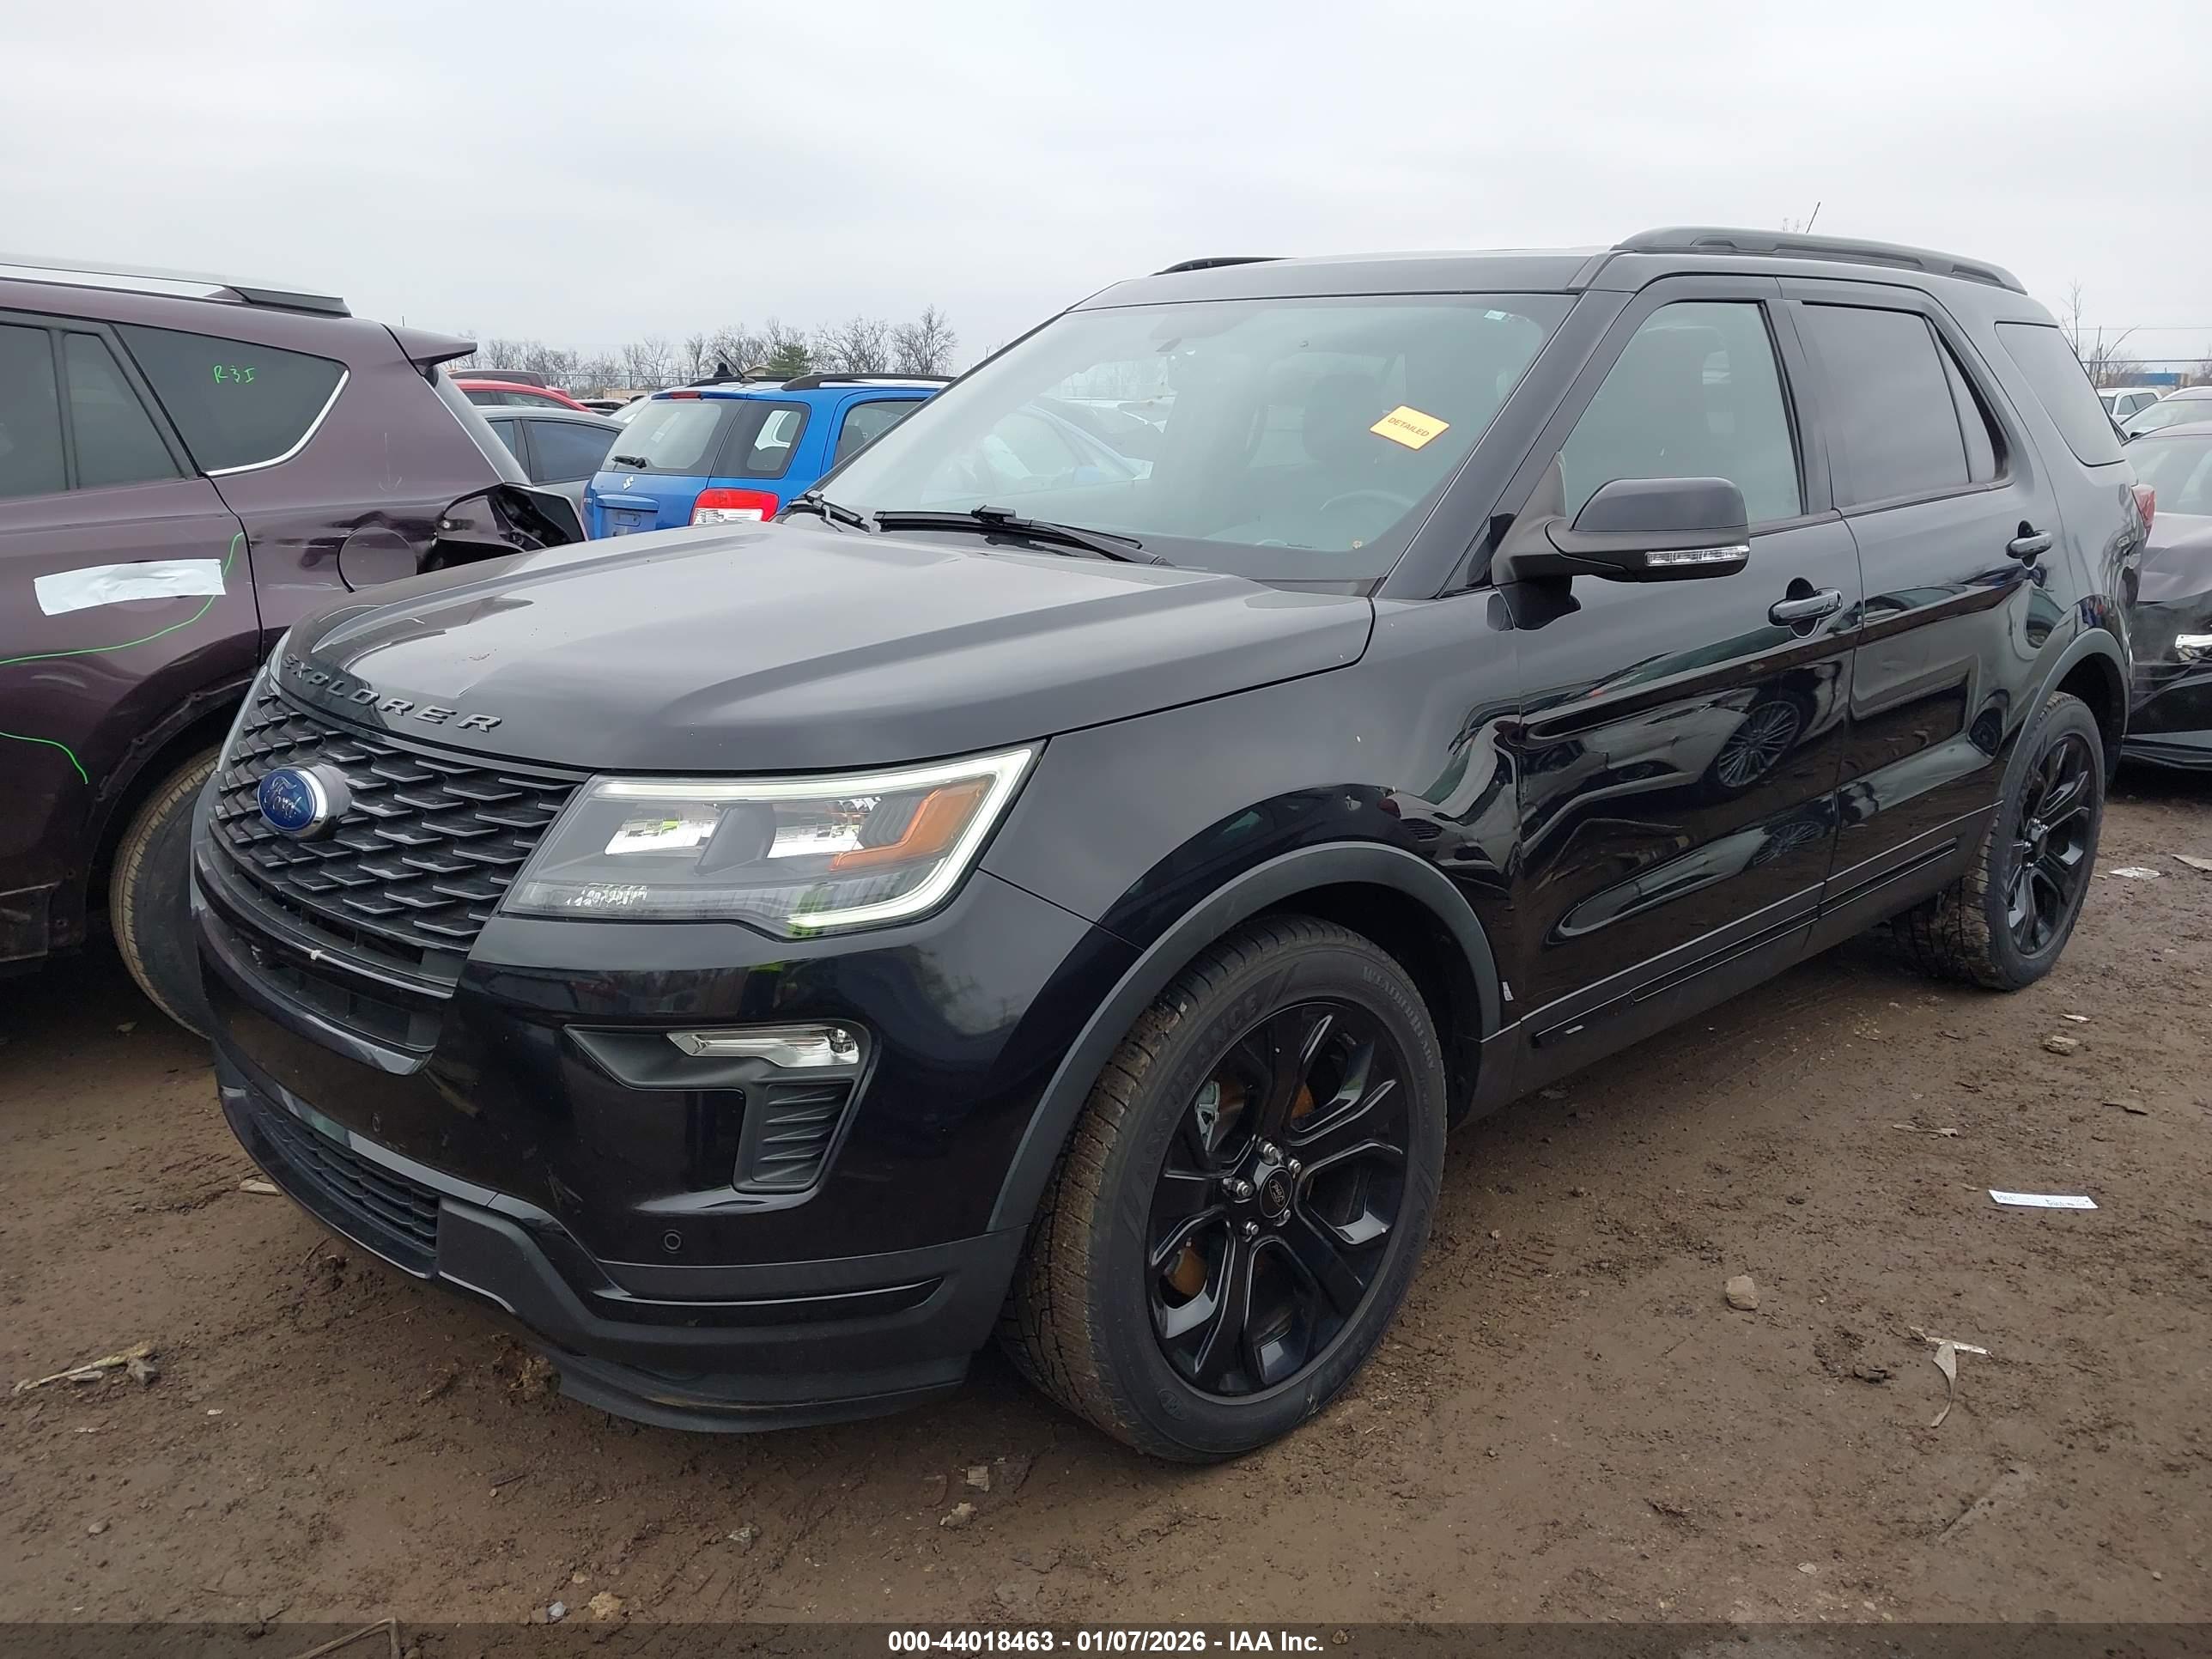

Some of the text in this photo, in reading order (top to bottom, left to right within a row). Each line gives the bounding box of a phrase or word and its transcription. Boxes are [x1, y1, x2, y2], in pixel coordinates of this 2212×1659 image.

[1388, 417, 1430, 437] DETAILED
[282, 653, 502, 732] EXPLORER
[264, 775, 302, 819] Ford
